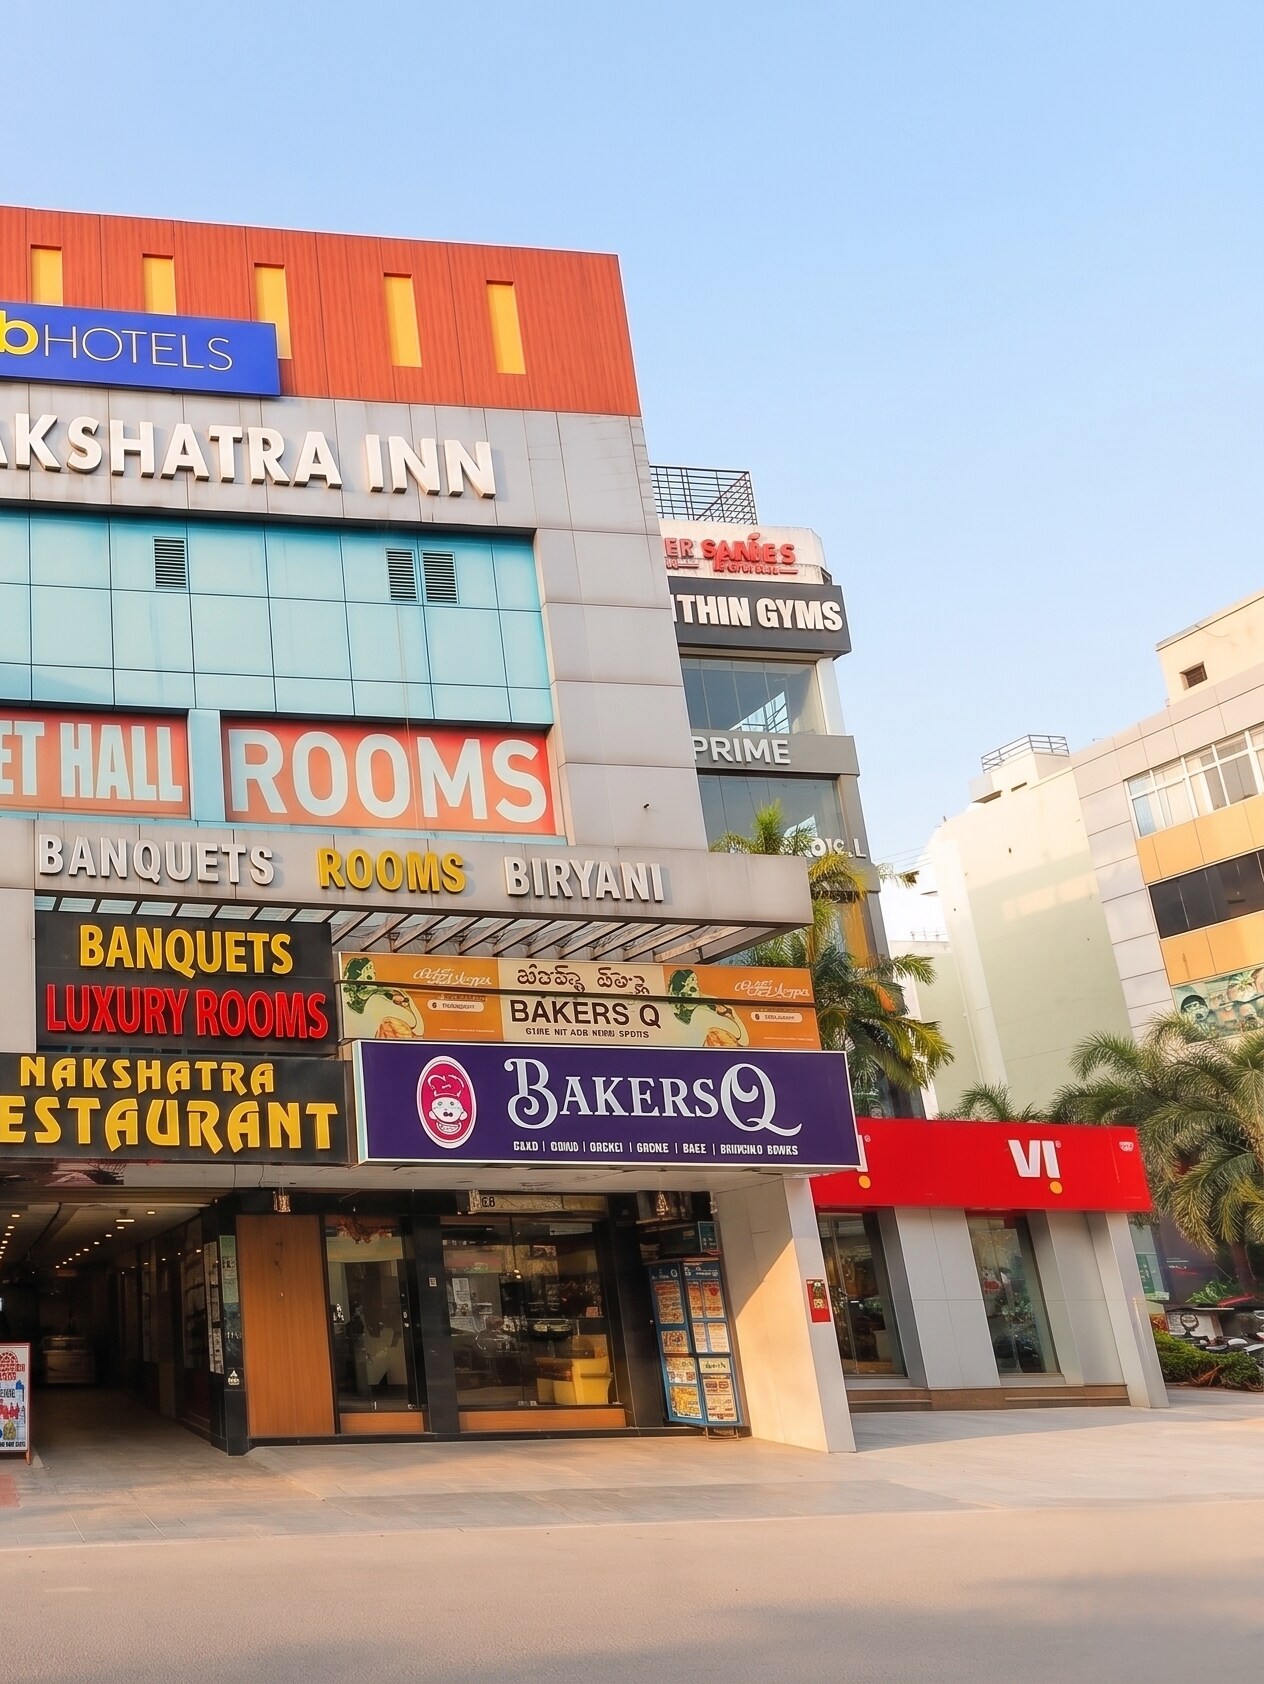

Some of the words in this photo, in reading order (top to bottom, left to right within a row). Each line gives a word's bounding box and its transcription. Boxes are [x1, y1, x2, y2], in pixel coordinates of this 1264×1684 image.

[366, 433, 496, 499] INN
[756, 597, 844, 631] GYMS
[60, 722, 184, 803] HALL
[228, 728, 548, 824] ROOMS
[691, 736, 791, 764] PRIME
[39, 833, 275, 886] BANQUETS
[316, 847, 467, 893] ROOMS
[504, 856, 665, 903] BIRYANI
[78, 924, 294, 979] BANQUETS
[46, 983, 190, 1036] LUXURY
[195, 988, 329, 1040] ROOMS
[510, 1000, 630, 1026] BAKERS
[639, 1003, 661, 1029] Q
[20, 1056, 276, 1097] NAKSHATRA
